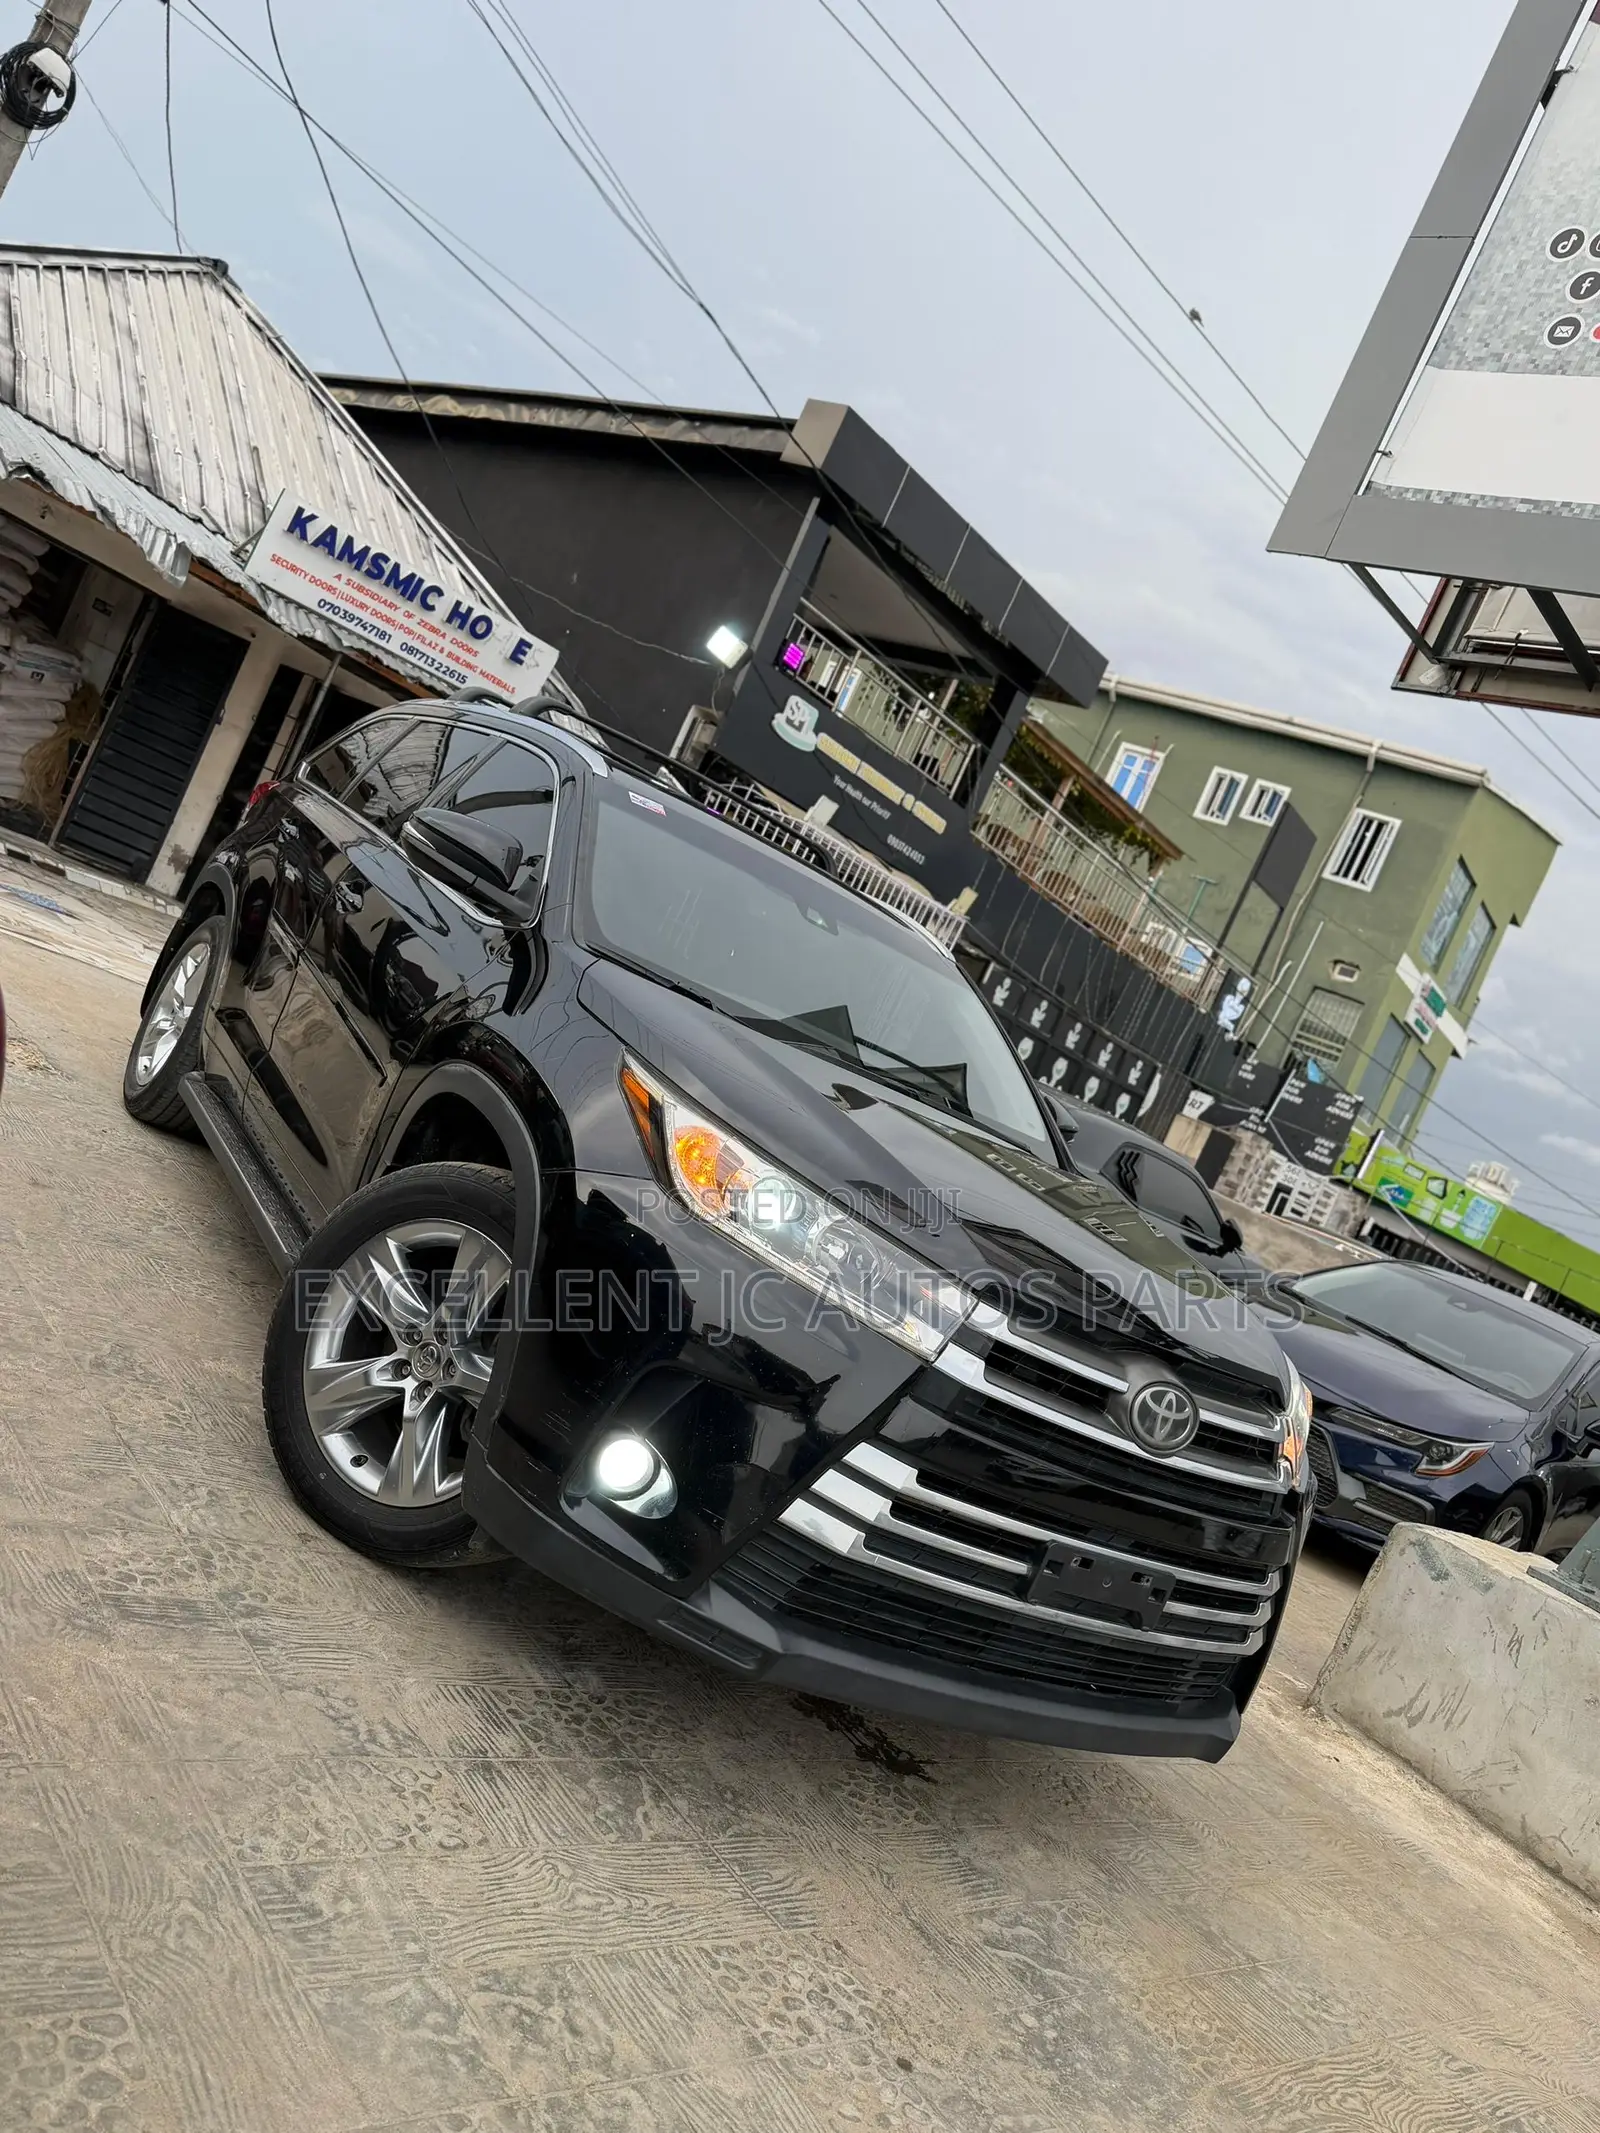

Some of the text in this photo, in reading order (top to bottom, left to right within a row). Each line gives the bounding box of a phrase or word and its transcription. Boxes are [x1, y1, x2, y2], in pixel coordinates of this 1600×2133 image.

[287, 506, 444, 611] KAMSMIC
[270, 553, 310, 578] SECURITY
[446, 650, 479, 673] BUILDING
[479, 669, 517, 694] MATERIALS
[316, 597, 468, 684] 07039747181 08171322615
[333, 572, 480, 658] A SUBSIDIARY OF ZEBRA DOORS
